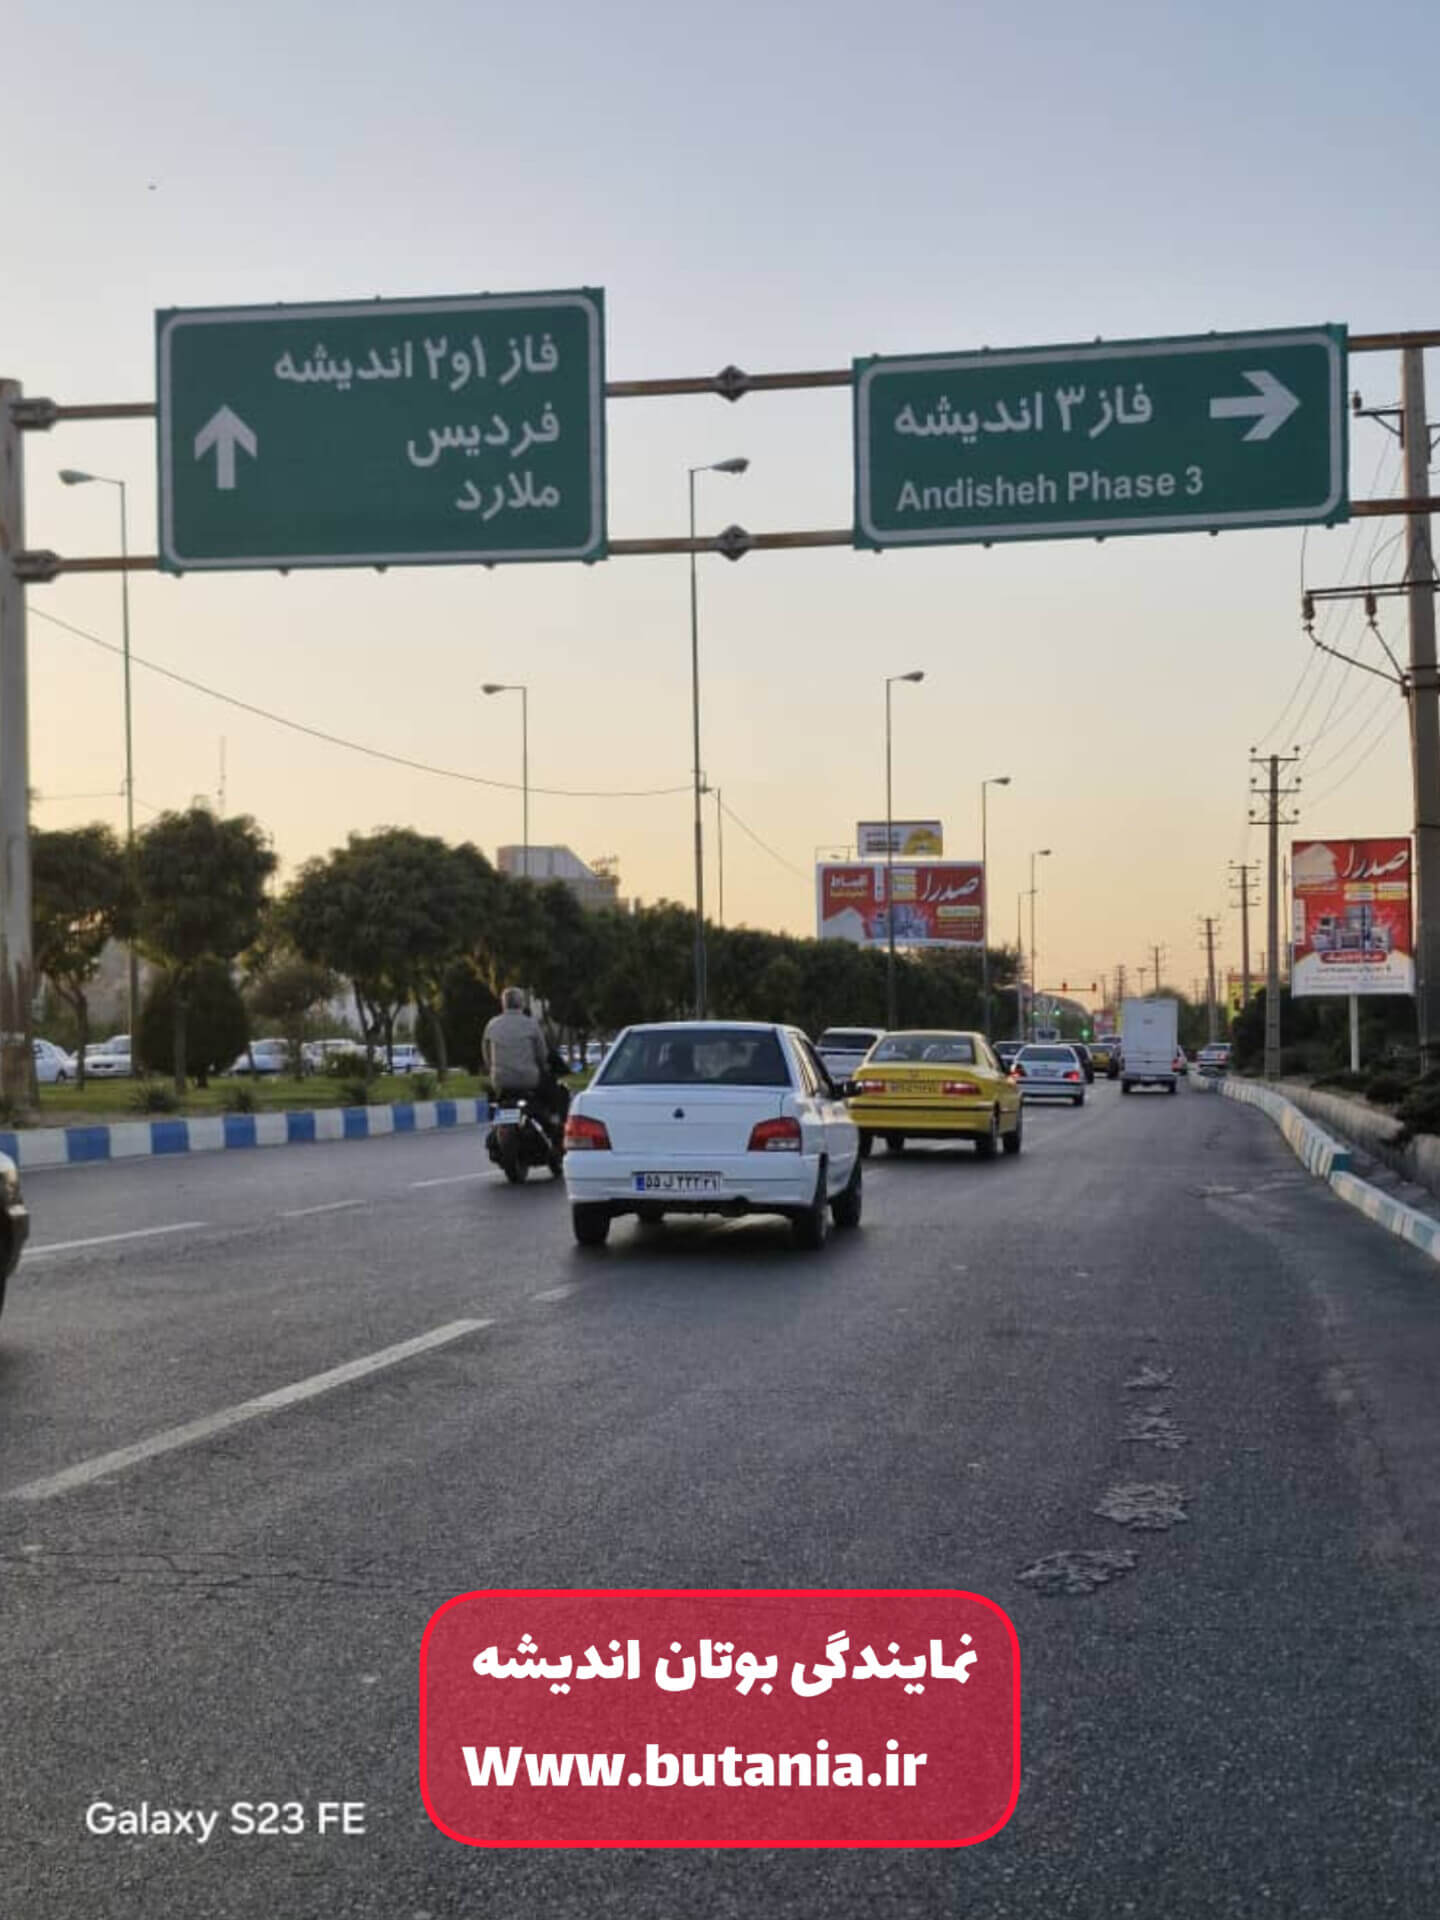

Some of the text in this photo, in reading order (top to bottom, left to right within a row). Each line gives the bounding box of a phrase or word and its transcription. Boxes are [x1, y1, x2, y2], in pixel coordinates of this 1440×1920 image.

[274, 338, 413, 391] اندیشه
[499, 333, 559, 384] فاز
[407, 402, 560, 468] فردیس
[894, 391, 1043, 441] اندیشه
[455, 471, 560, 521] ملارد
[896, 465, 1203, 512] Andisheh Phase 3
[1341, 842, 1409, 879] صدرا
[920, 871, 979, 903] صدرا
